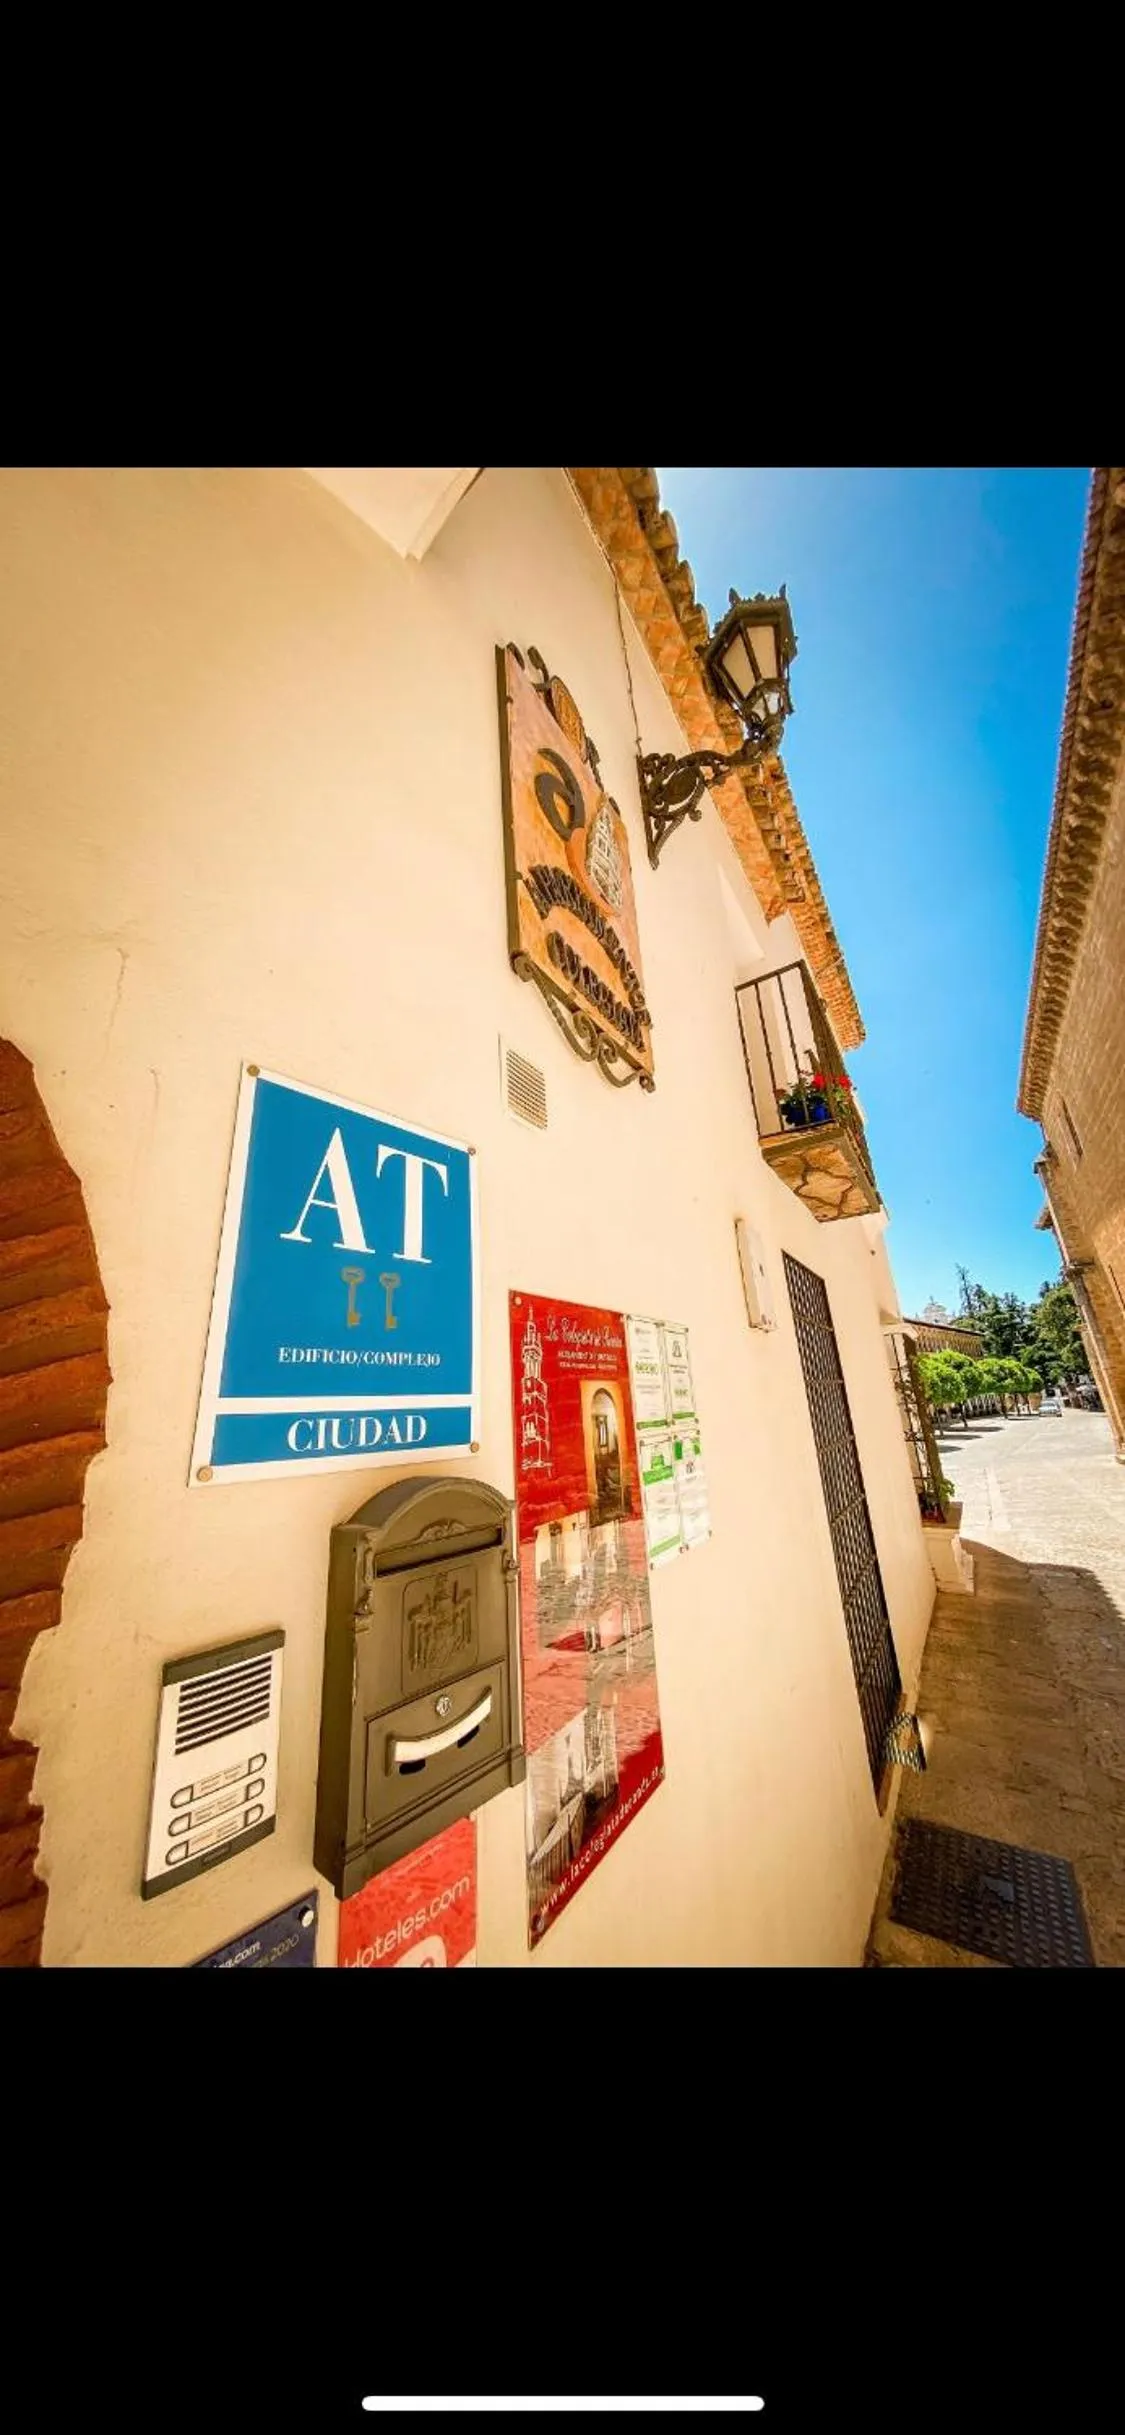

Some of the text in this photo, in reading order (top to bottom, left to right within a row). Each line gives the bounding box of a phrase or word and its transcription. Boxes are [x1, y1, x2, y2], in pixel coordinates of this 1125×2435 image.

[280, 1127, 449, 1264] AT
[278, 1347, 441, 1368] EDIFICIO/COMPLEJO
[287, 1414, 428, 1453] CIUDAD
[345, 1875, 471, 1967] Hoteles.com
